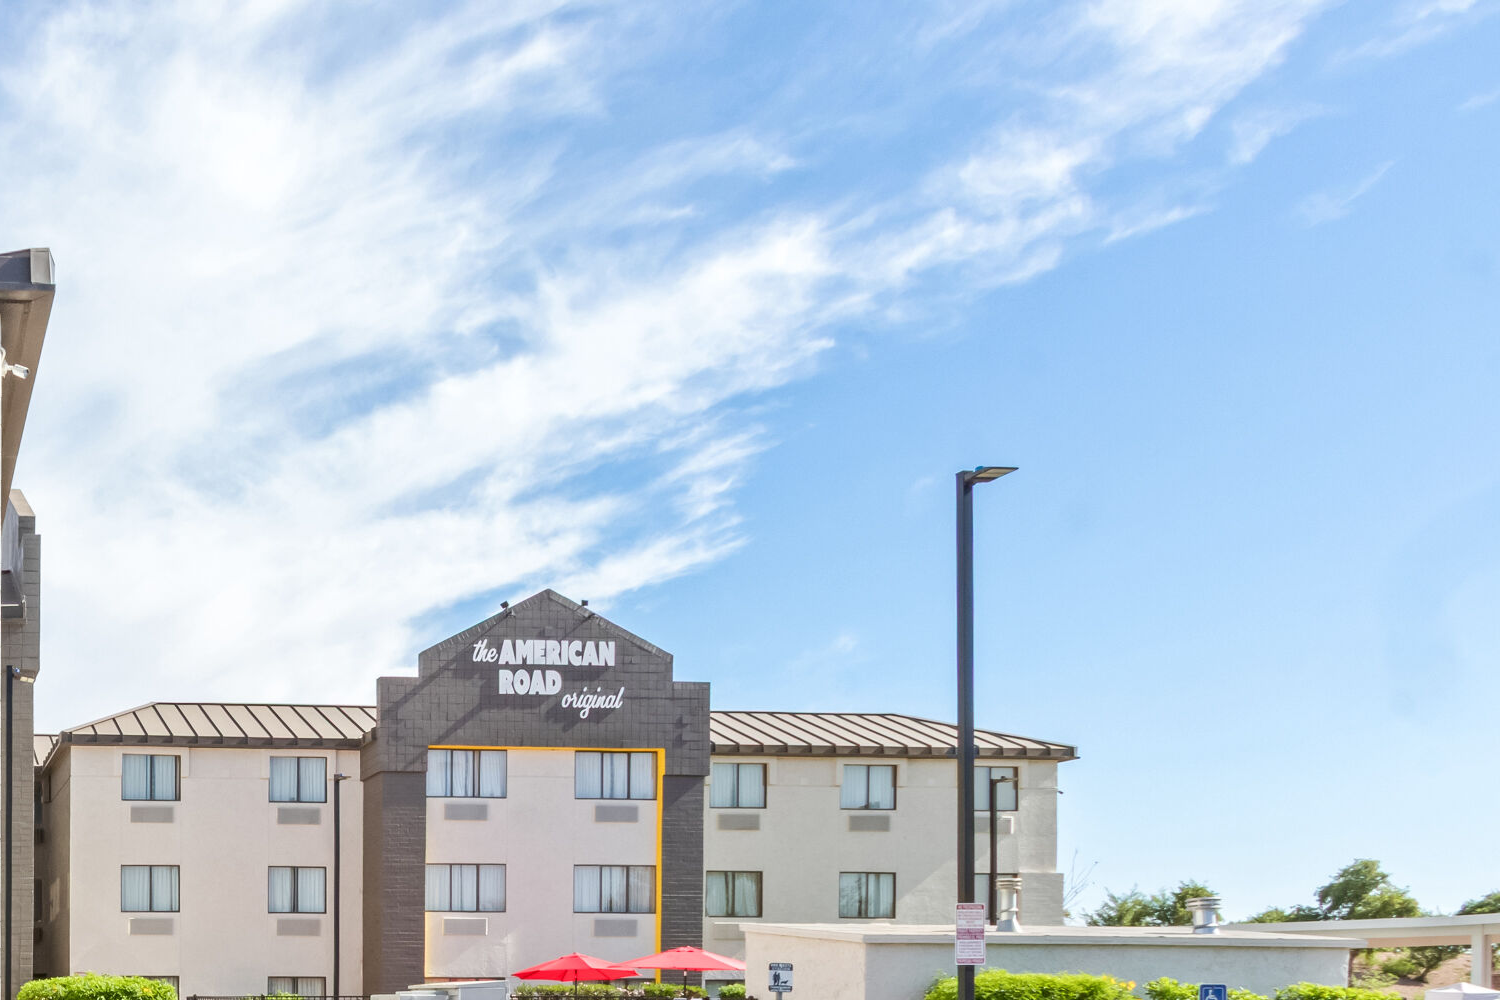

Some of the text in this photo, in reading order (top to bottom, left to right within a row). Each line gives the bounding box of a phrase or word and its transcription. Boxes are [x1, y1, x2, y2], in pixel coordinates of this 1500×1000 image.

[472, 638, 616, 667] the AMERICAN
[498, 669, 562, 695] ROAD
[561, 686, 625, 719] original
